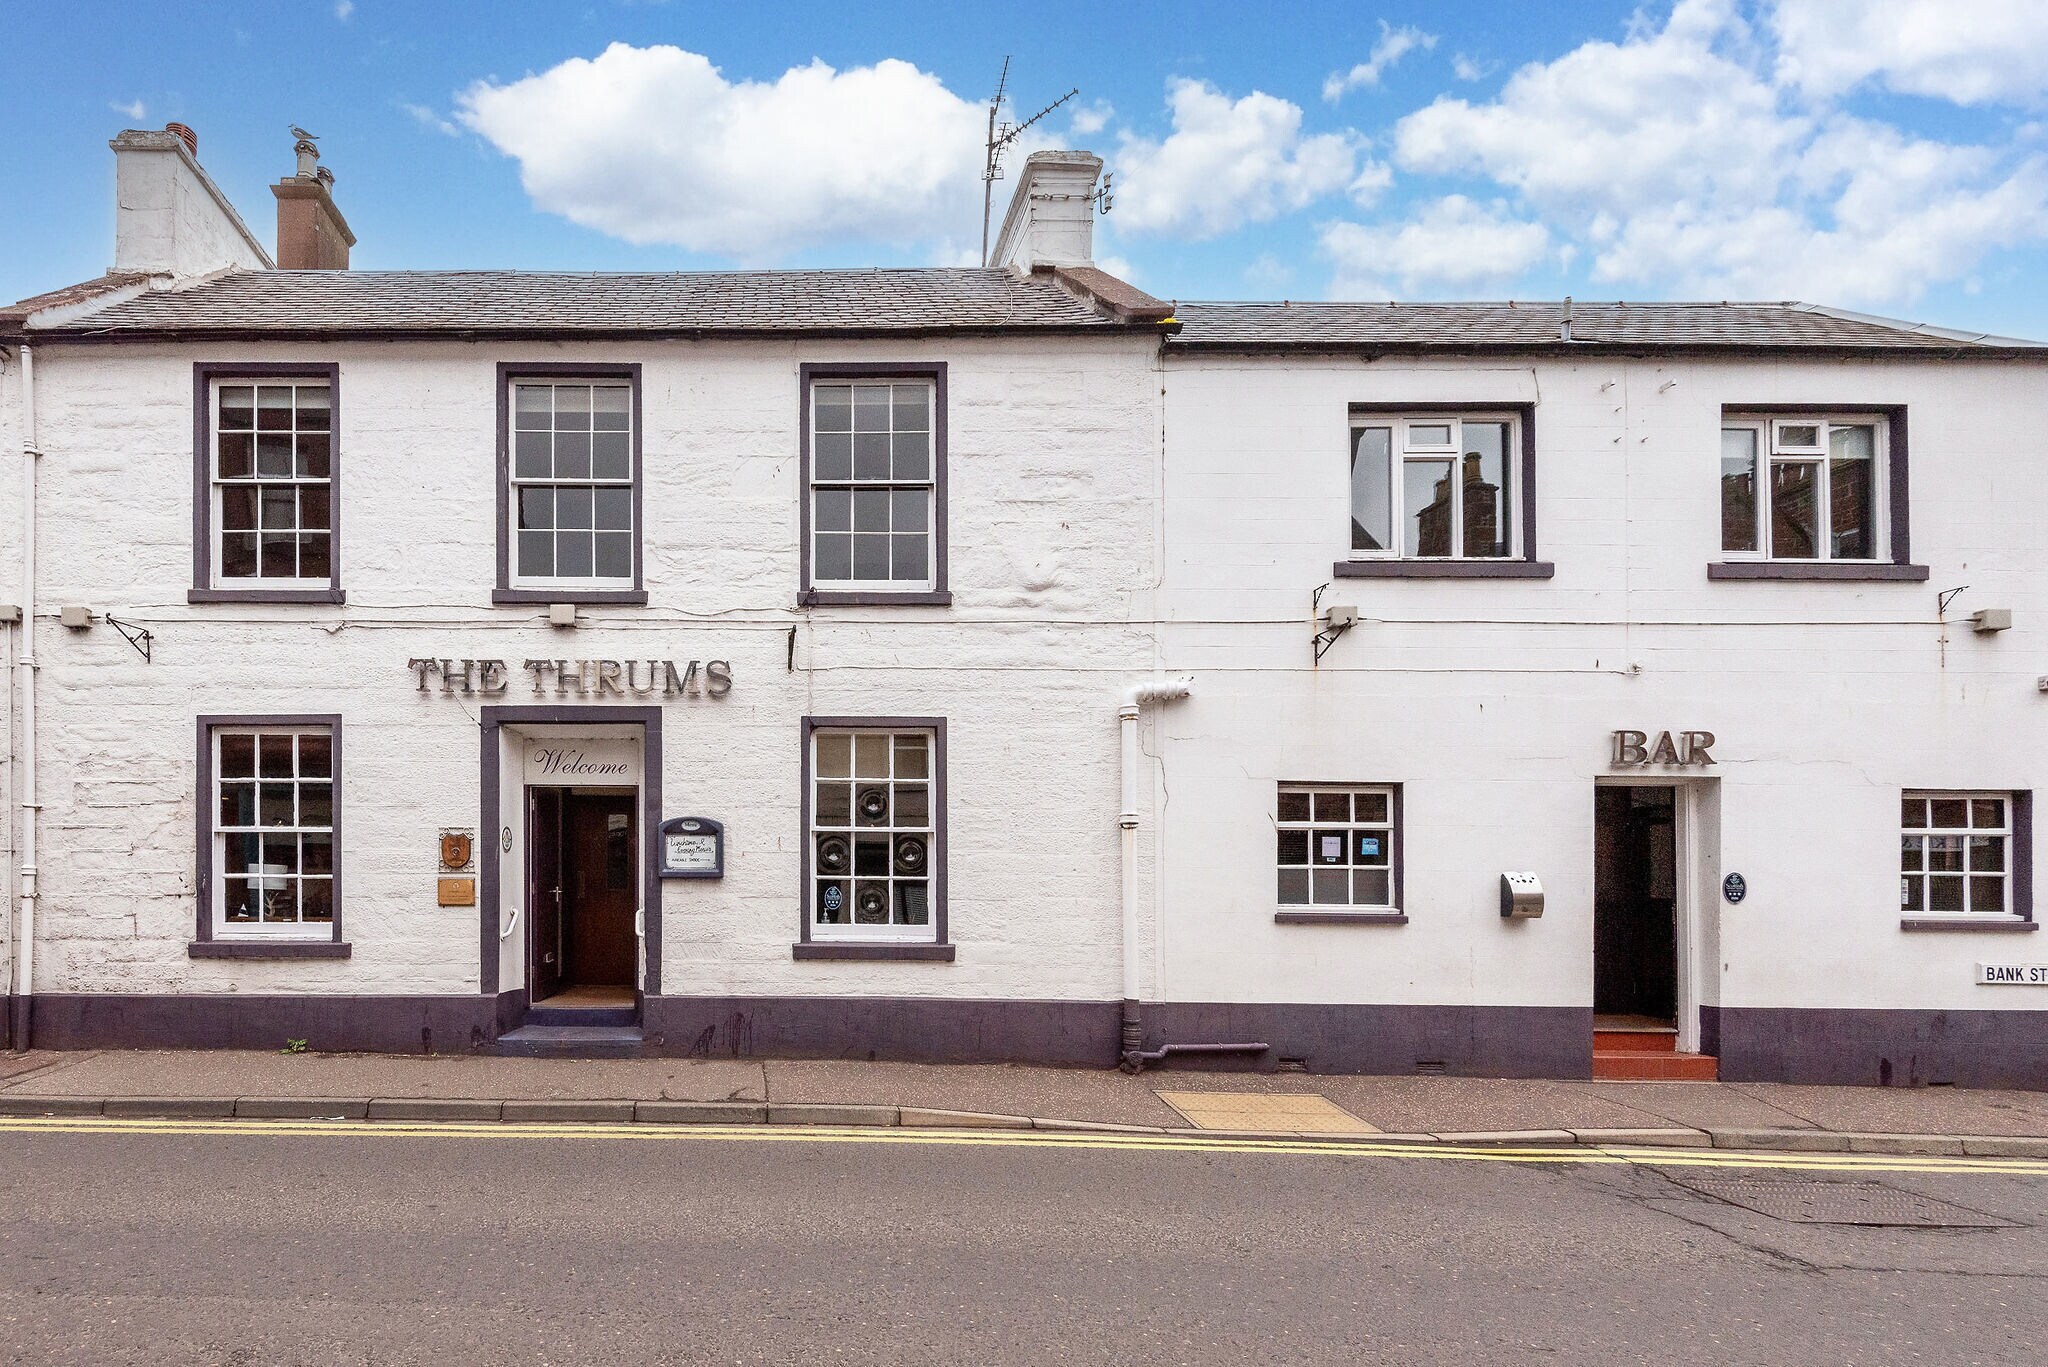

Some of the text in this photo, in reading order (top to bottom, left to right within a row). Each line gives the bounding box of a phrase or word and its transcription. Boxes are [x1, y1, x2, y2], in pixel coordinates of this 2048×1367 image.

[408, 657, 733, 697] THE THRUMS
[534, 748, 629, 776] Welcome
[1610, 730, 1717, 766] BAR
[1986, 967, 2024, 981] BANK
